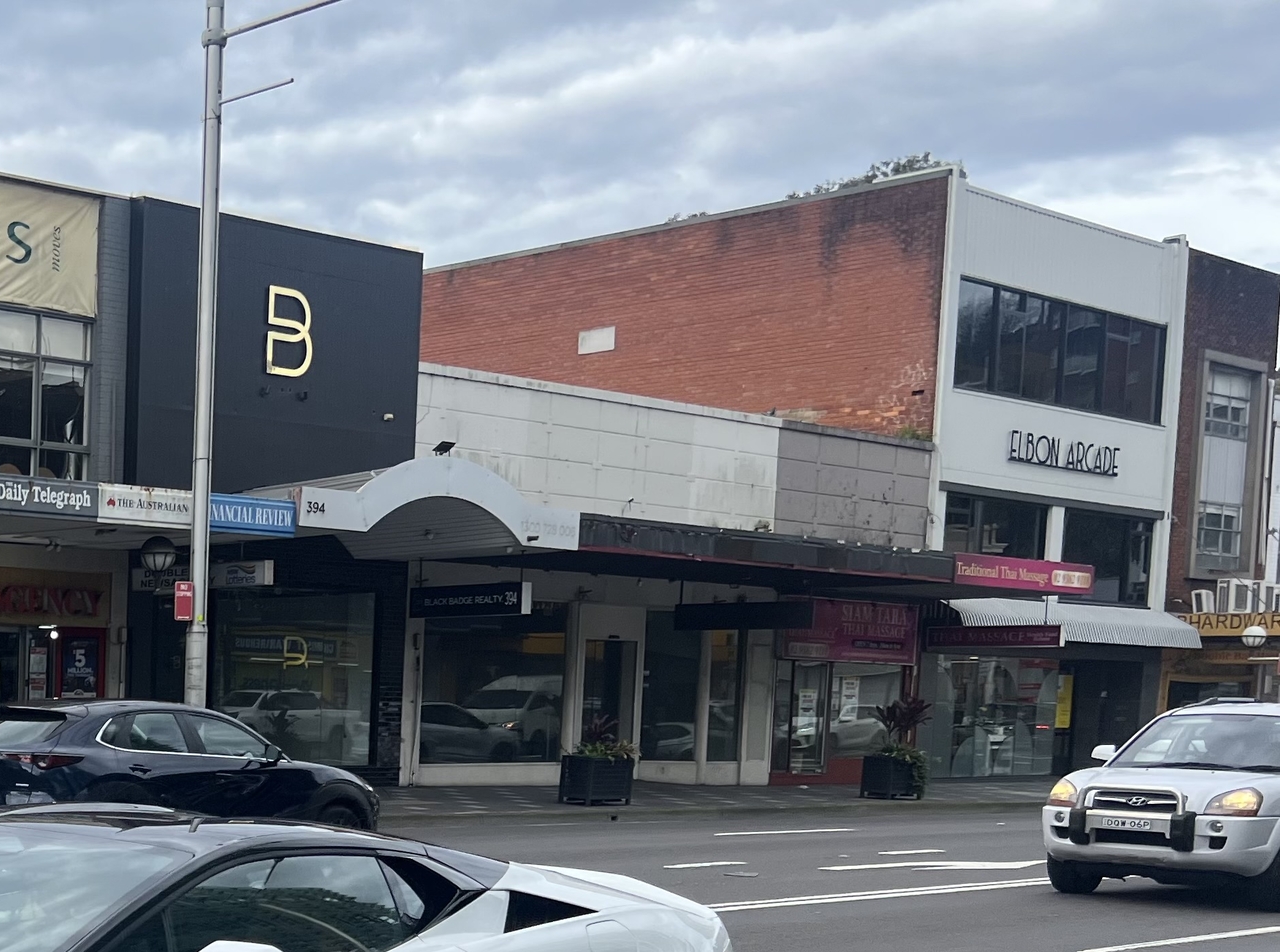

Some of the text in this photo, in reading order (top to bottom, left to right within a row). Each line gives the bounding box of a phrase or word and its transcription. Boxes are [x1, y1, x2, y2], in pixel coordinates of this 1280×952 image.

[52, 225, 61, 272] moves
[266, 285, 313, 378] B
[1010, 430, 1120, 477] ELBON ARCADE
[32, 486, 91, 510] Telegraph
[117, 498, 189, 513] THE AUSTRALIAN
[306, 501, 326, 514] 394
[255, 507, 294, 527] REVIEW
[144, 568, 189, 578] DUBLE
[225, 574, 256, 585] Lotteries
[956, 562, 999, 578] Traditional
[1000, 566, 1018, 580] Thai
[1019, 567, 1050, 587] Massage
[424, 598, 447, 606] BLACK
[449, 596, 473, 605] BADGE
[504, 591, 518, 606] 394
[842, 604, 874, 622] SIAM
[842, 623, 906, 639] THAI MASSAGE
[969, 632, 1024, 643] MASSAGE
